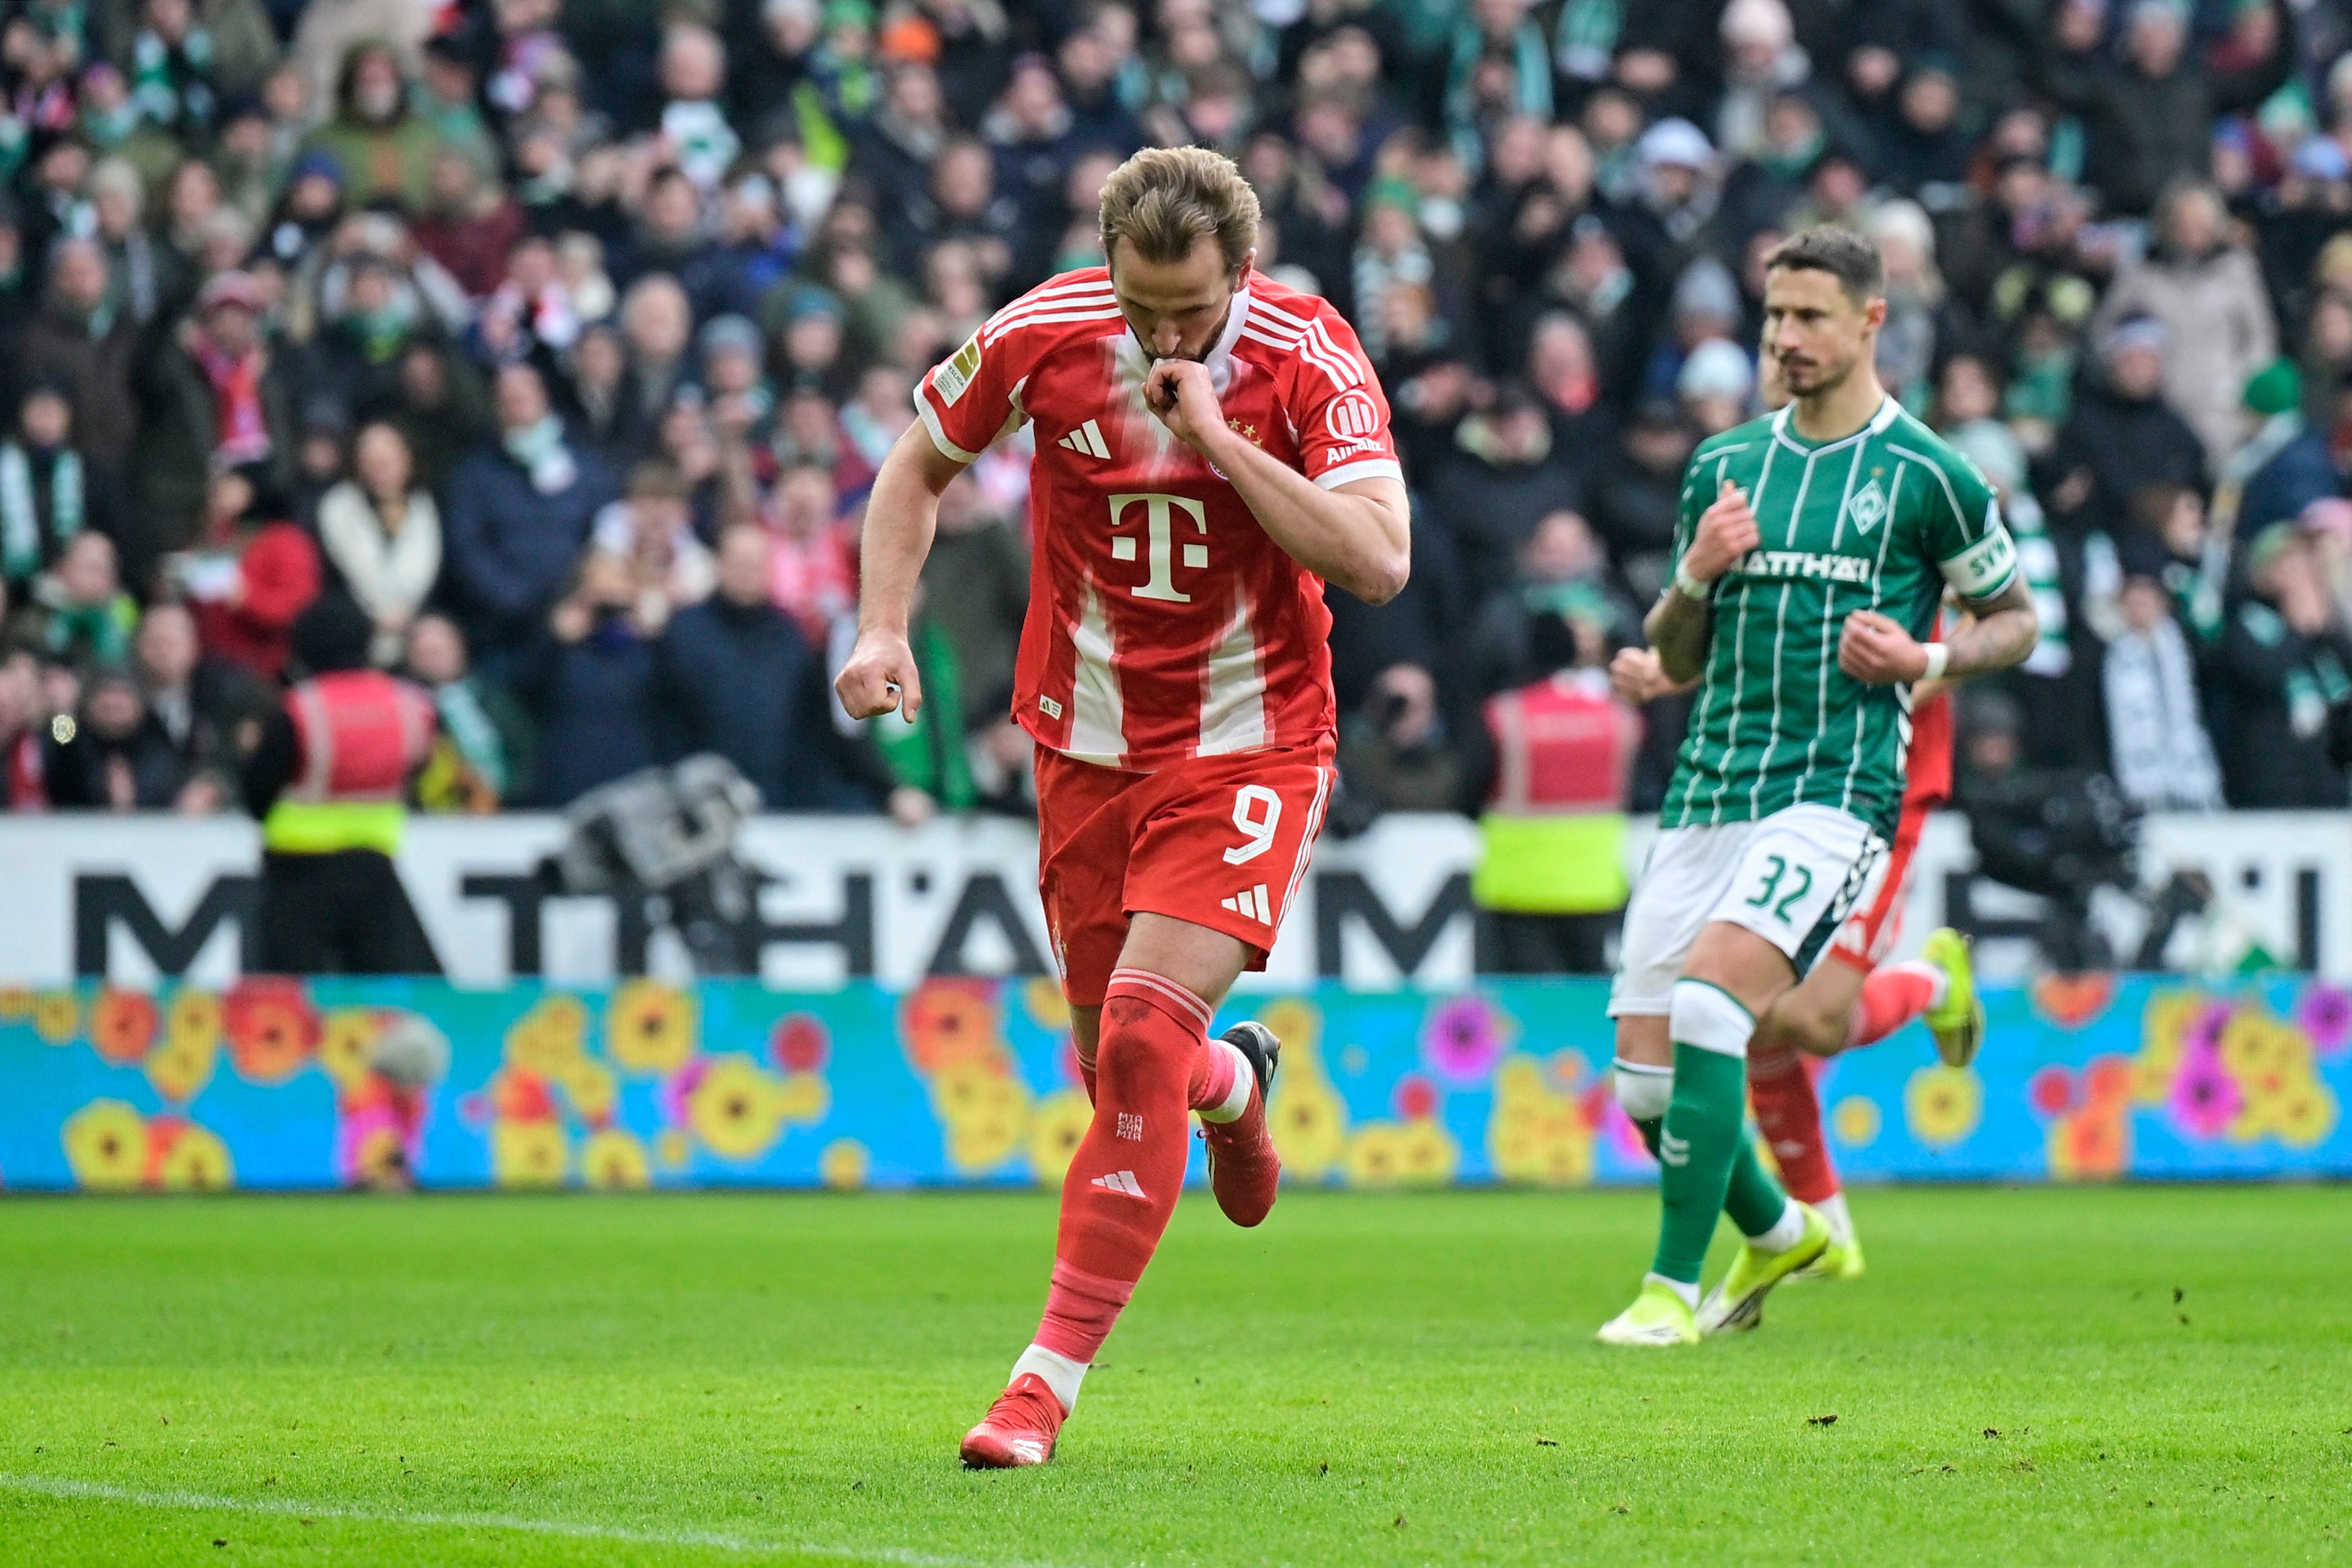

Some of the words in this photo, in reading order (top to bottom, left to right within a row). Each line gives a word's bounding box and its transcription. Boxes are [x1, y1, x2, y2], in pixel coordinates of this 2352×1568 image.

[1108, 493, 1208, 602] T
[1223, 784, 1283, 865] 9
[1746, 855, 1812, 923] 32
[1116, 1128, 1141, 1141] MIA
[1118, 1112, 1143, 1124] MIA
[1118, 1121, 1142, 1133] SAN
